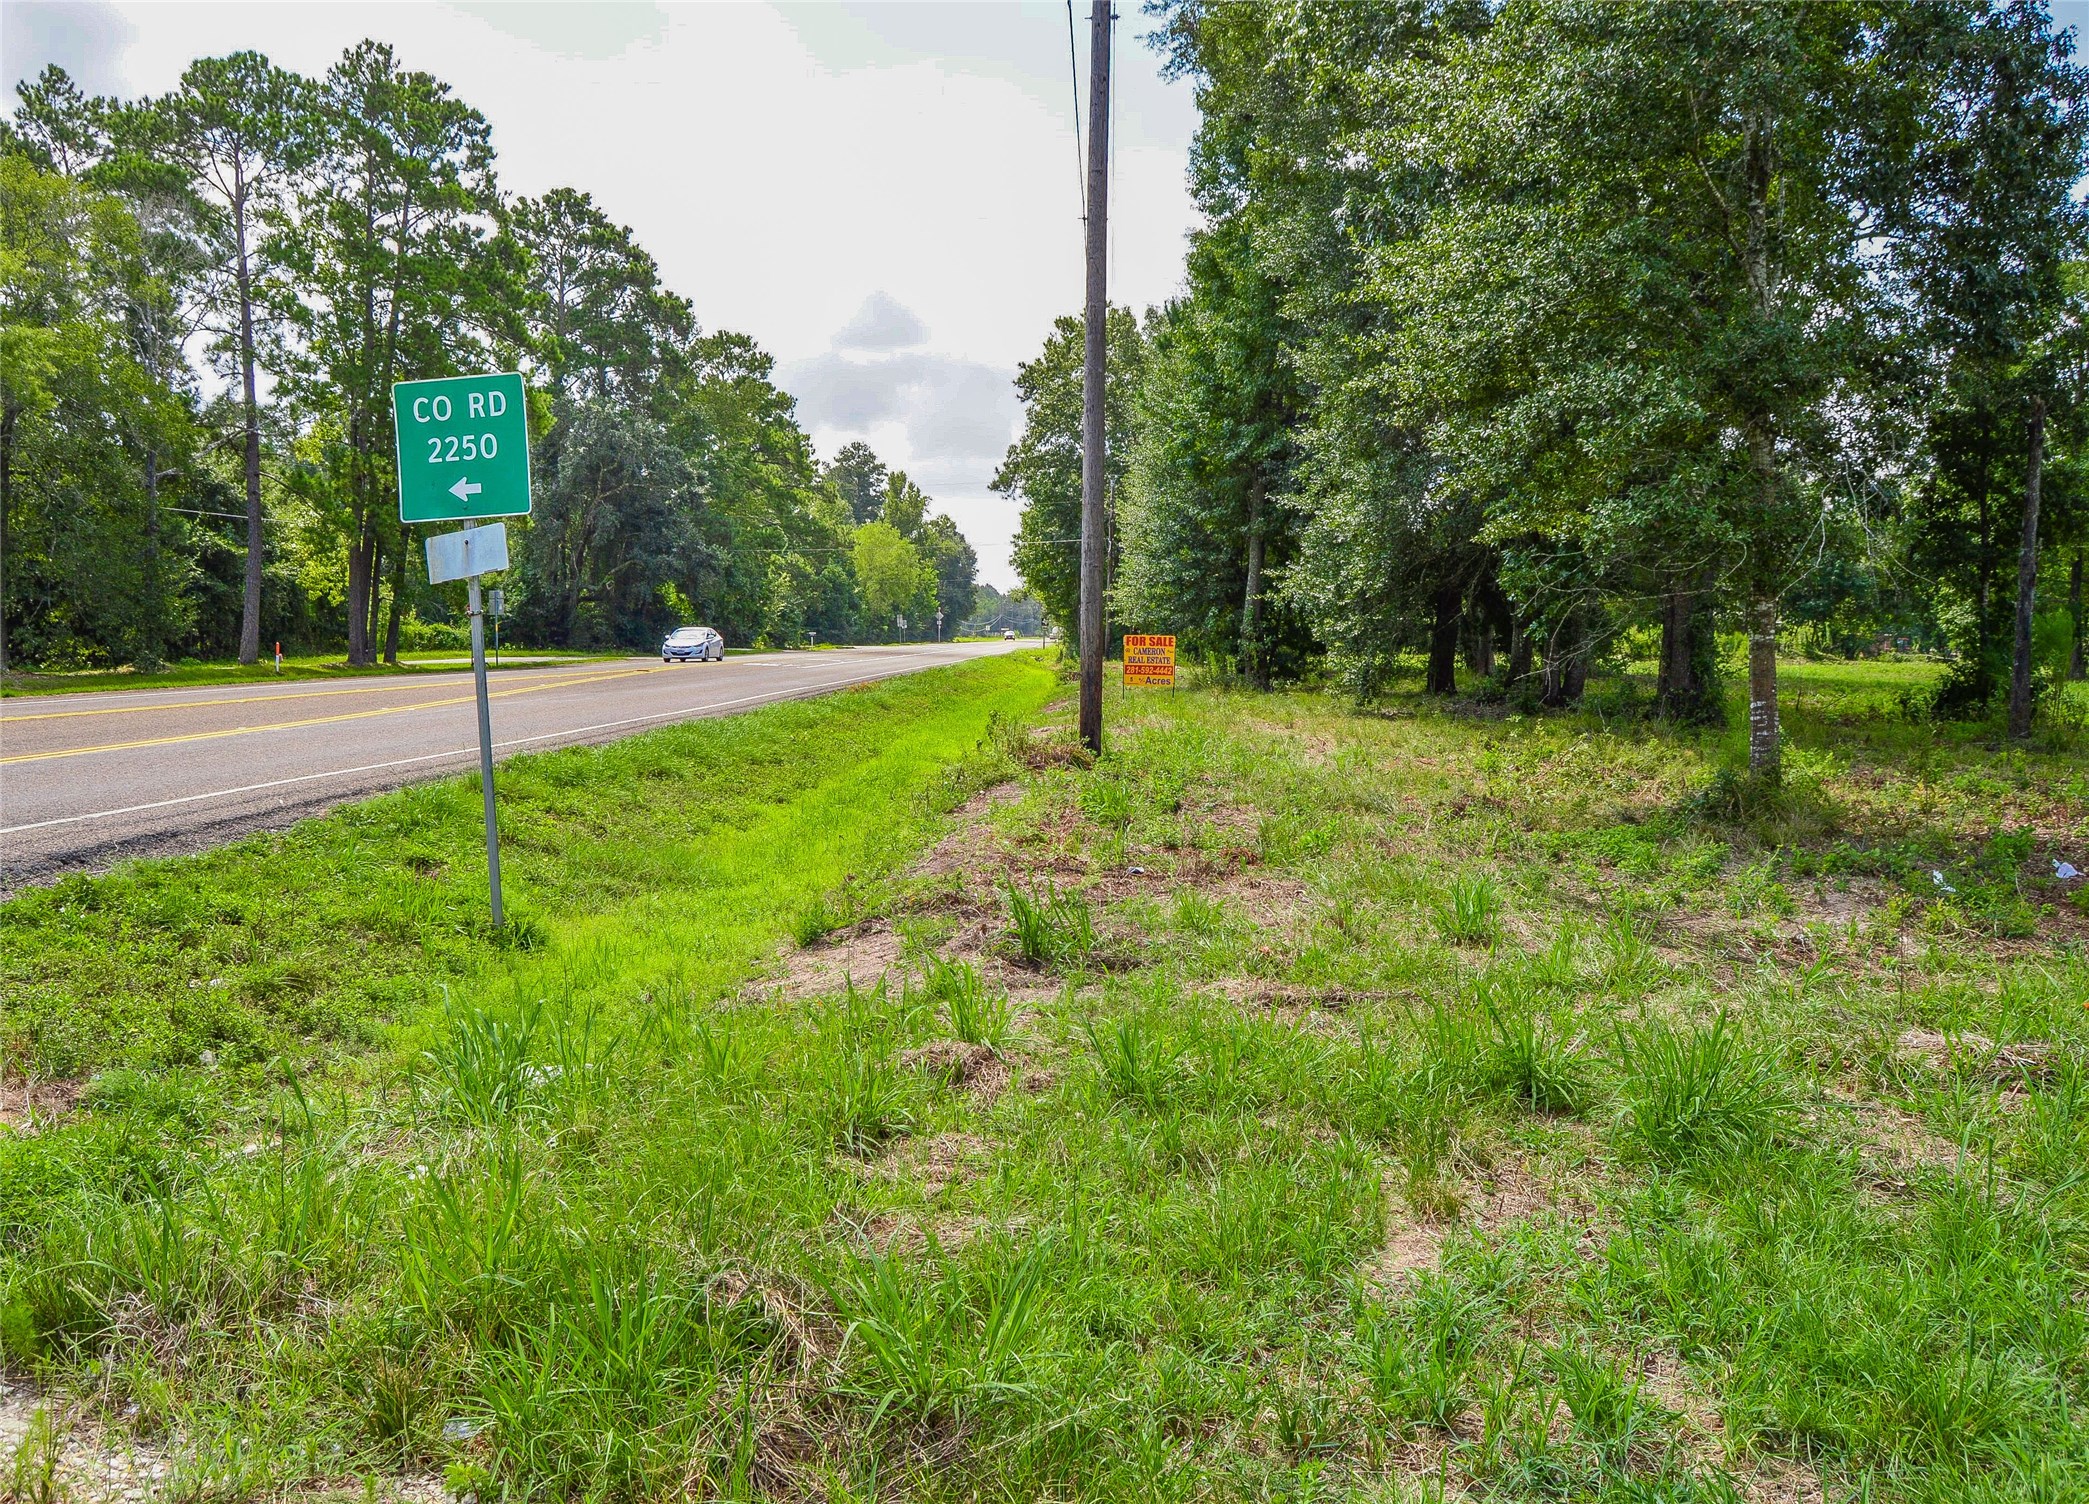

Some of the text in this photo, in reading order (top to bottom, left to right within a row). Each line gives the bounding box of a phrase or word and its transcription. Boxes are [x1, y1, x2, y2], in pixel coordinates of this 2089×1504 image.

[413, 390, 507, 423] CO RD
[427, 433, 498, 463] 2250
[1126, 636, 1174, 646] FOR SALE
[1134, 647, 1165, 655] CAMERON
[1147, 656, 1171, 664] ESTATE
[1145, 676, 1171, 685] Acres
